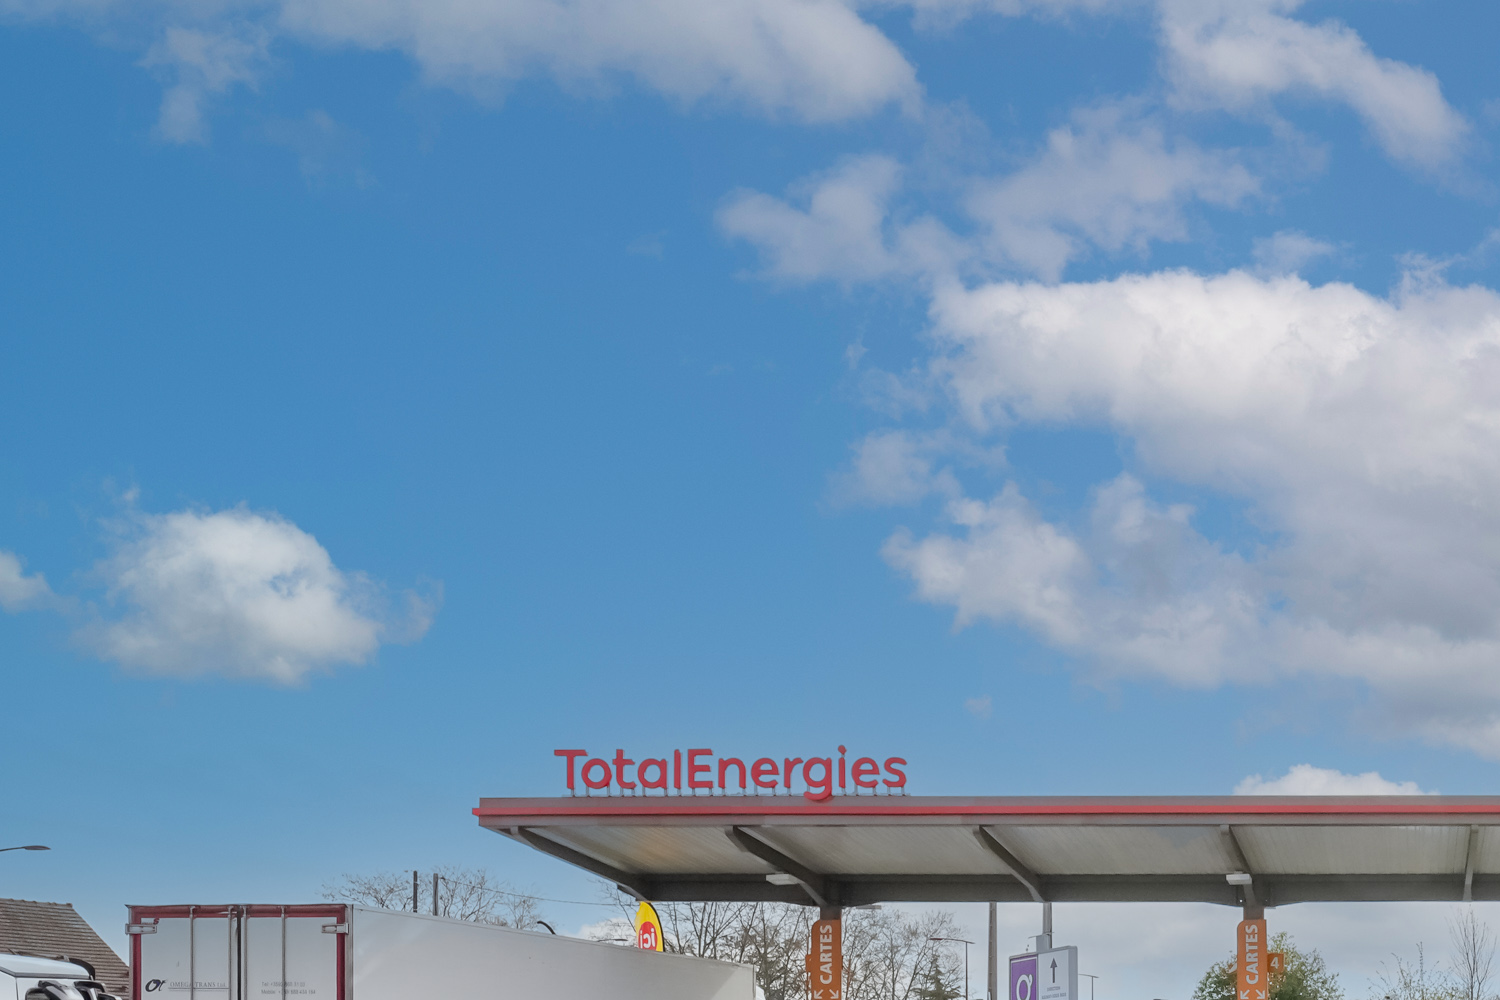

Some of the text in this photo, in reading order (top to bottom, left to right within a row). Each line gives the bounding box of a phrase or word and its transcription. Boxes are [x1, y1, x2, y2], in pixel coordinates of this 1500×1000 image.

[554, 745, 907, 800] TotalEnergies
[820, 924, 832, 984] CARTES
[1246, 924, 1258, 984] CARTES
[1270, 957, 1279, 969] 4
